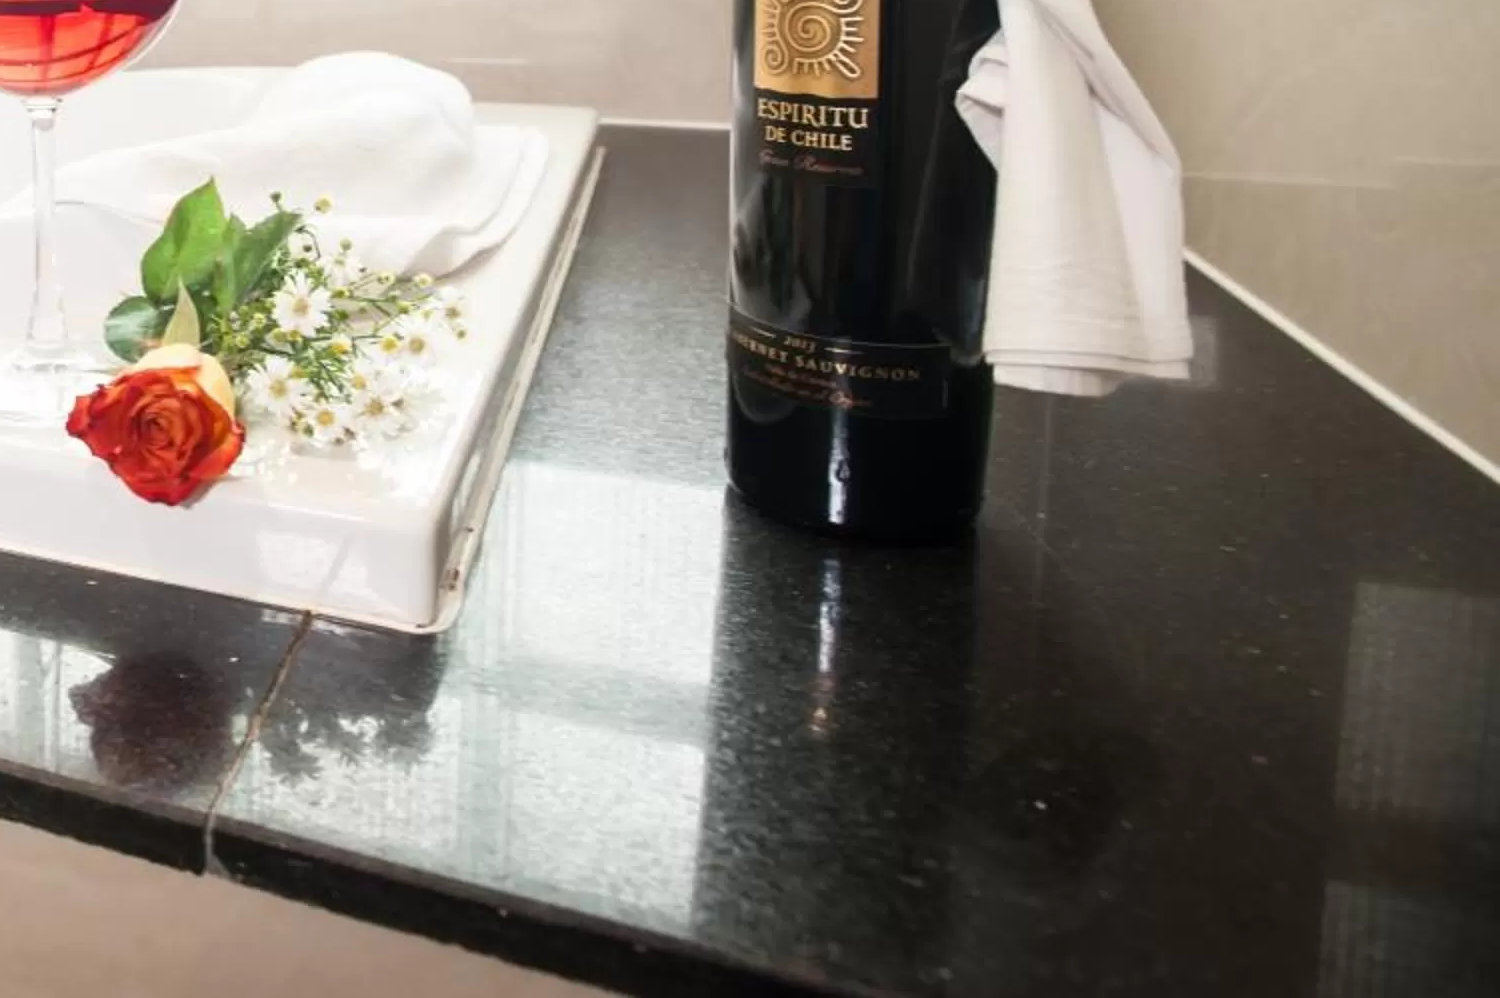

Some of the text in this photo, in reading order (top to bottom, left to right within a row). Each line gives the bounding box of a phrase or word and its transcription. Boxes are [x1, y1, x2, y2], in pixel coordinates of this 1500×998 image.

[757, 97, 869, 129] ESPIRITU
[764, 125, 853, 151] DE CHILE
[795, 355, 921, 381] SAUVIGNON
